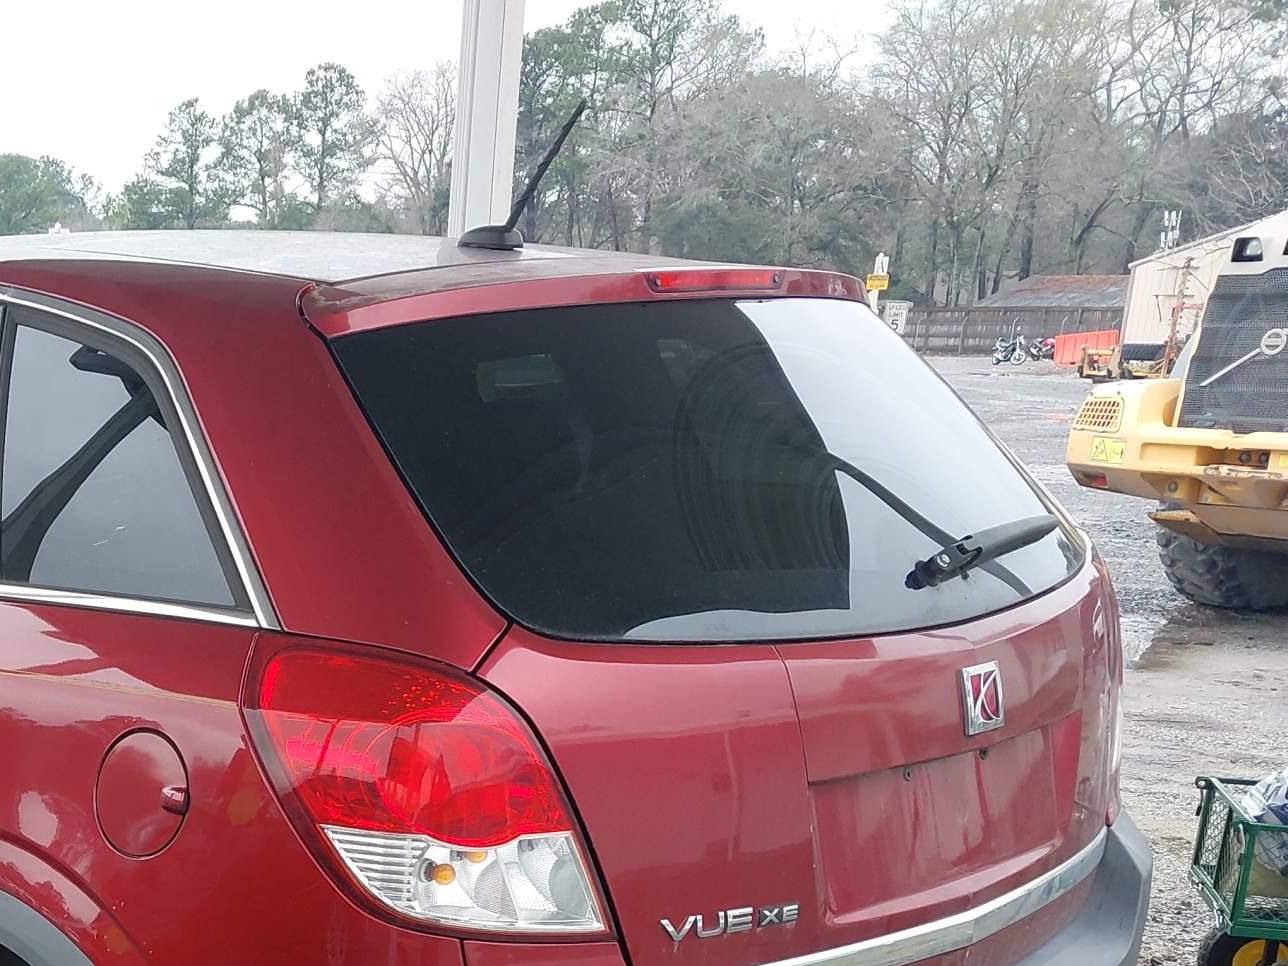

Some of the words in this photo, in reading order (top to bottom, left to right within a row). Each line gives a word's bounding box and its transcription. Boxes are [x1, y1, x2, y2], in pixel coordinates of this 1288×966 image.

[891, 319, 899, 331] 5
[660, 906, 754, 942] VUE
[760, 904, 799, 926] XE
